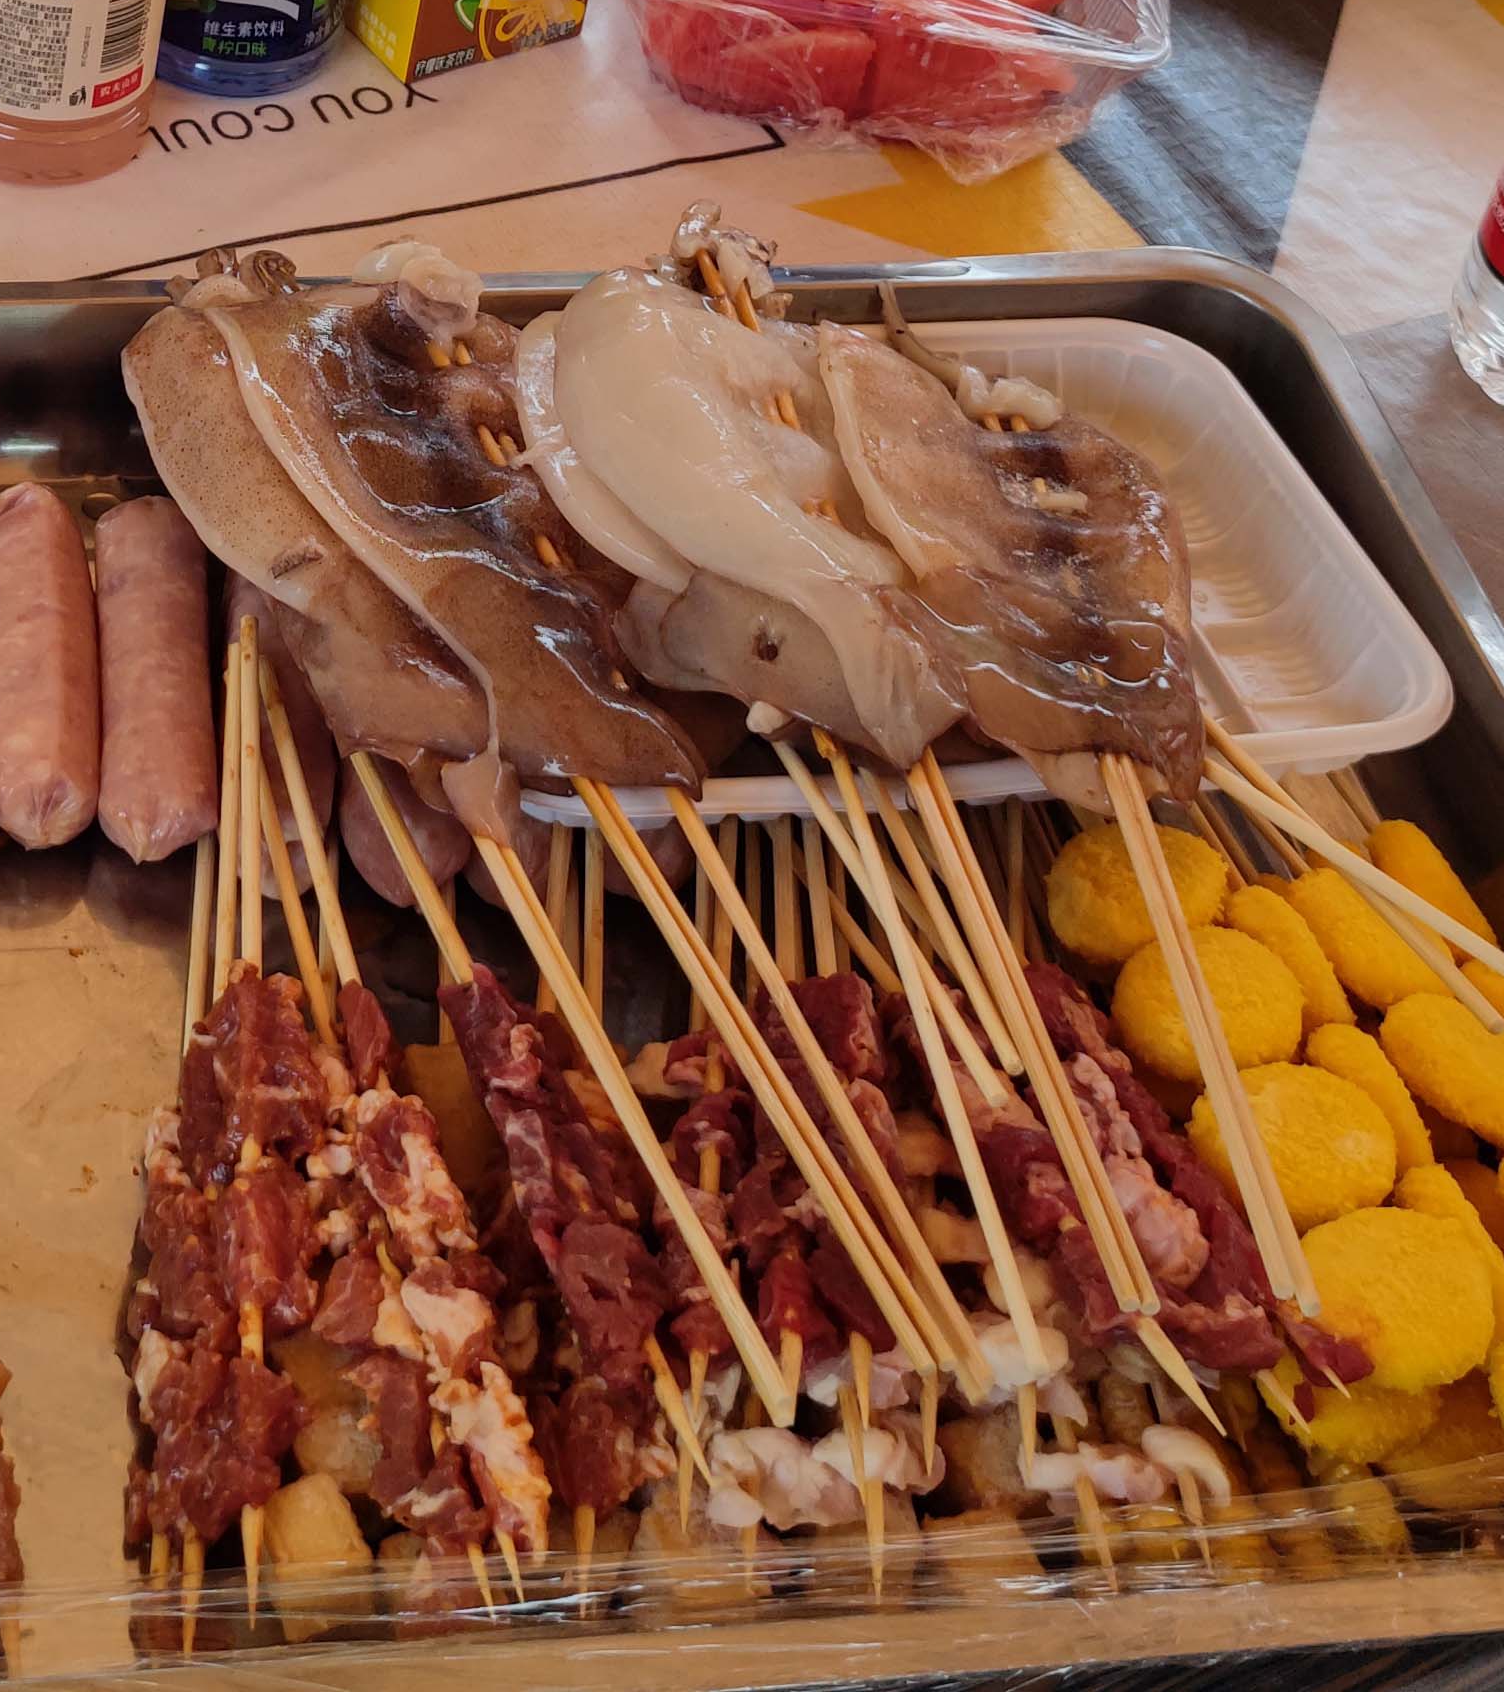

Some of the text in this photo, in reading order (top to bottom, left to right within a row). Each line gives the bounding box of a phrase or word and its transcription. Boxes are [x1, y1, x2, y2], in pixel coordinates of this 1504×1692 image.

[203, 19, 285, 38] 维生素饮料
[201, 36, 268, 57] 青柠口味
[310, 83, 439, 125] YOU
[142, 103, 296, 153] COUL
